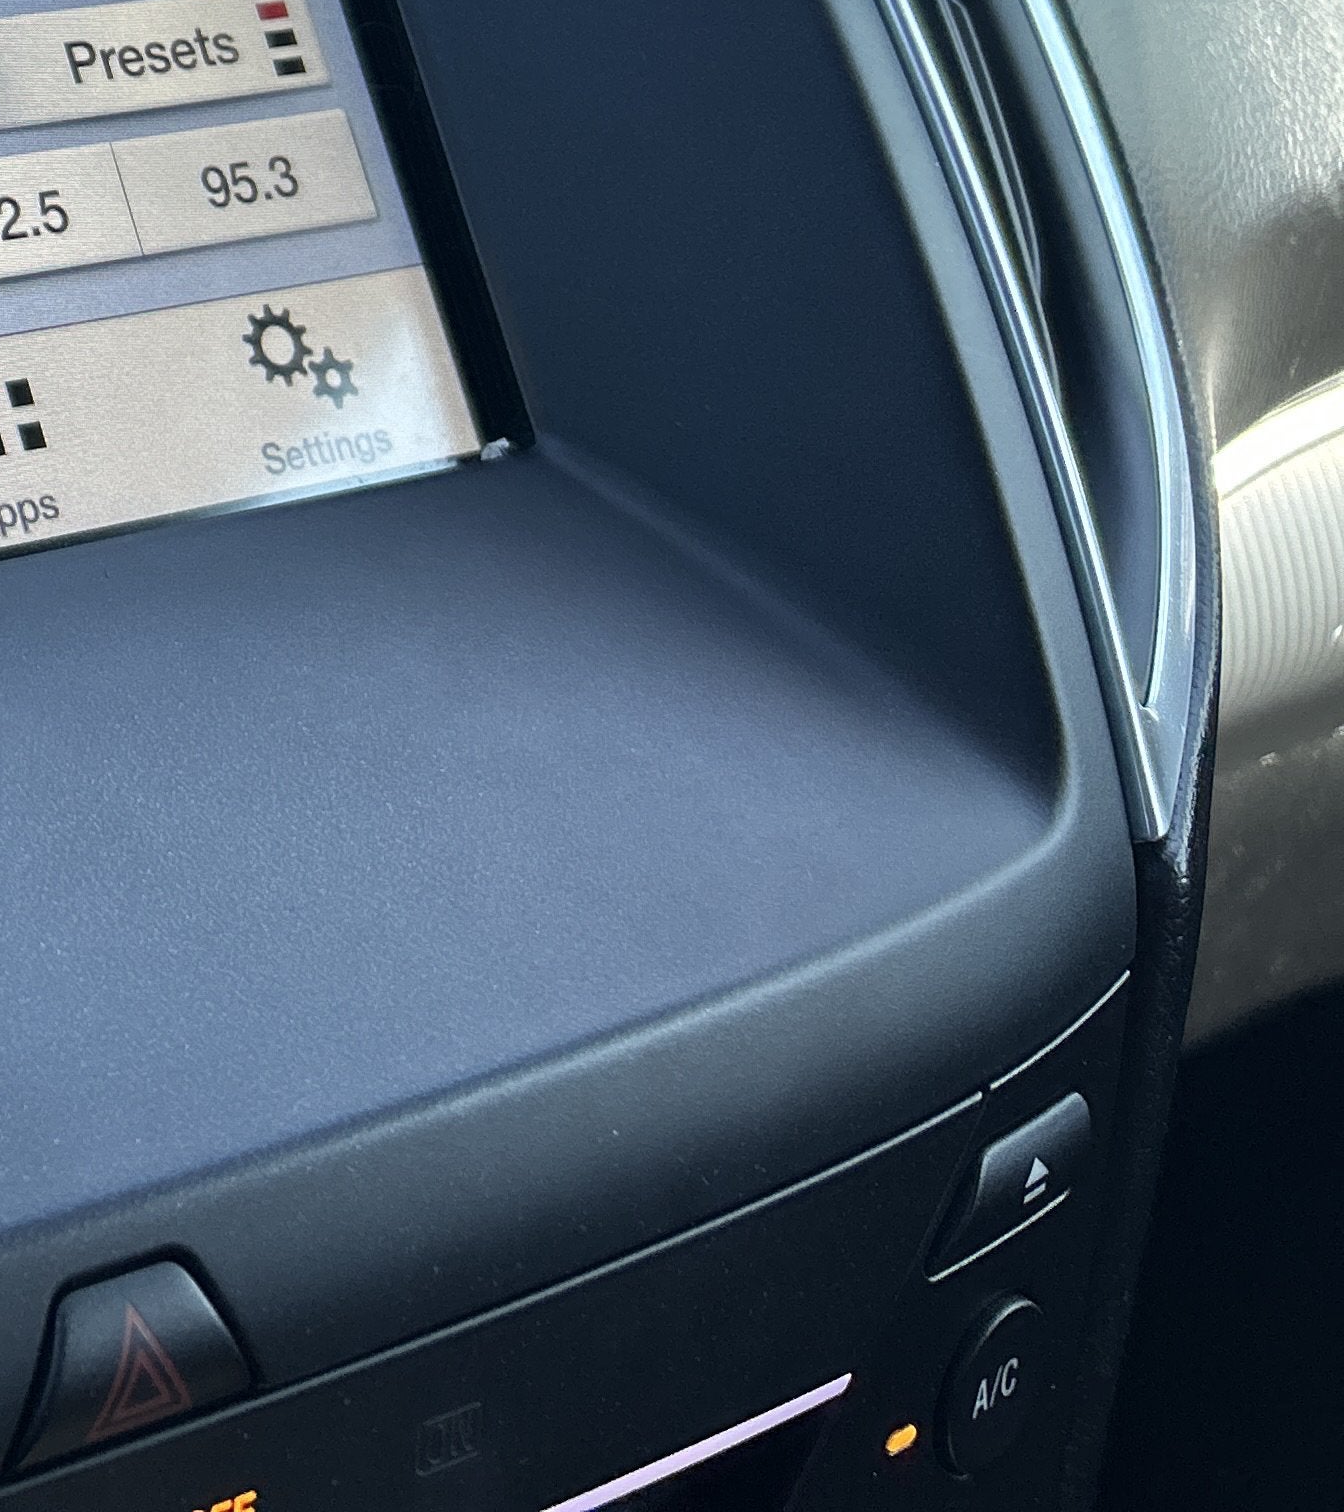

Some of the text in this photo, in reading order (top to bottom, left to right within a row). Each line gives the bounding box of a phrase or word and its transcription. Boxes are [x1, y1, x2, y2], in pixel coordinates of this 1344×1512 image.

[64, 28, 240, 84] Presets
[201, 155, 299, 209] 95.3
[260, 423, 393, 476] Settings
[972, 1358, 1018, 1418] A/C
